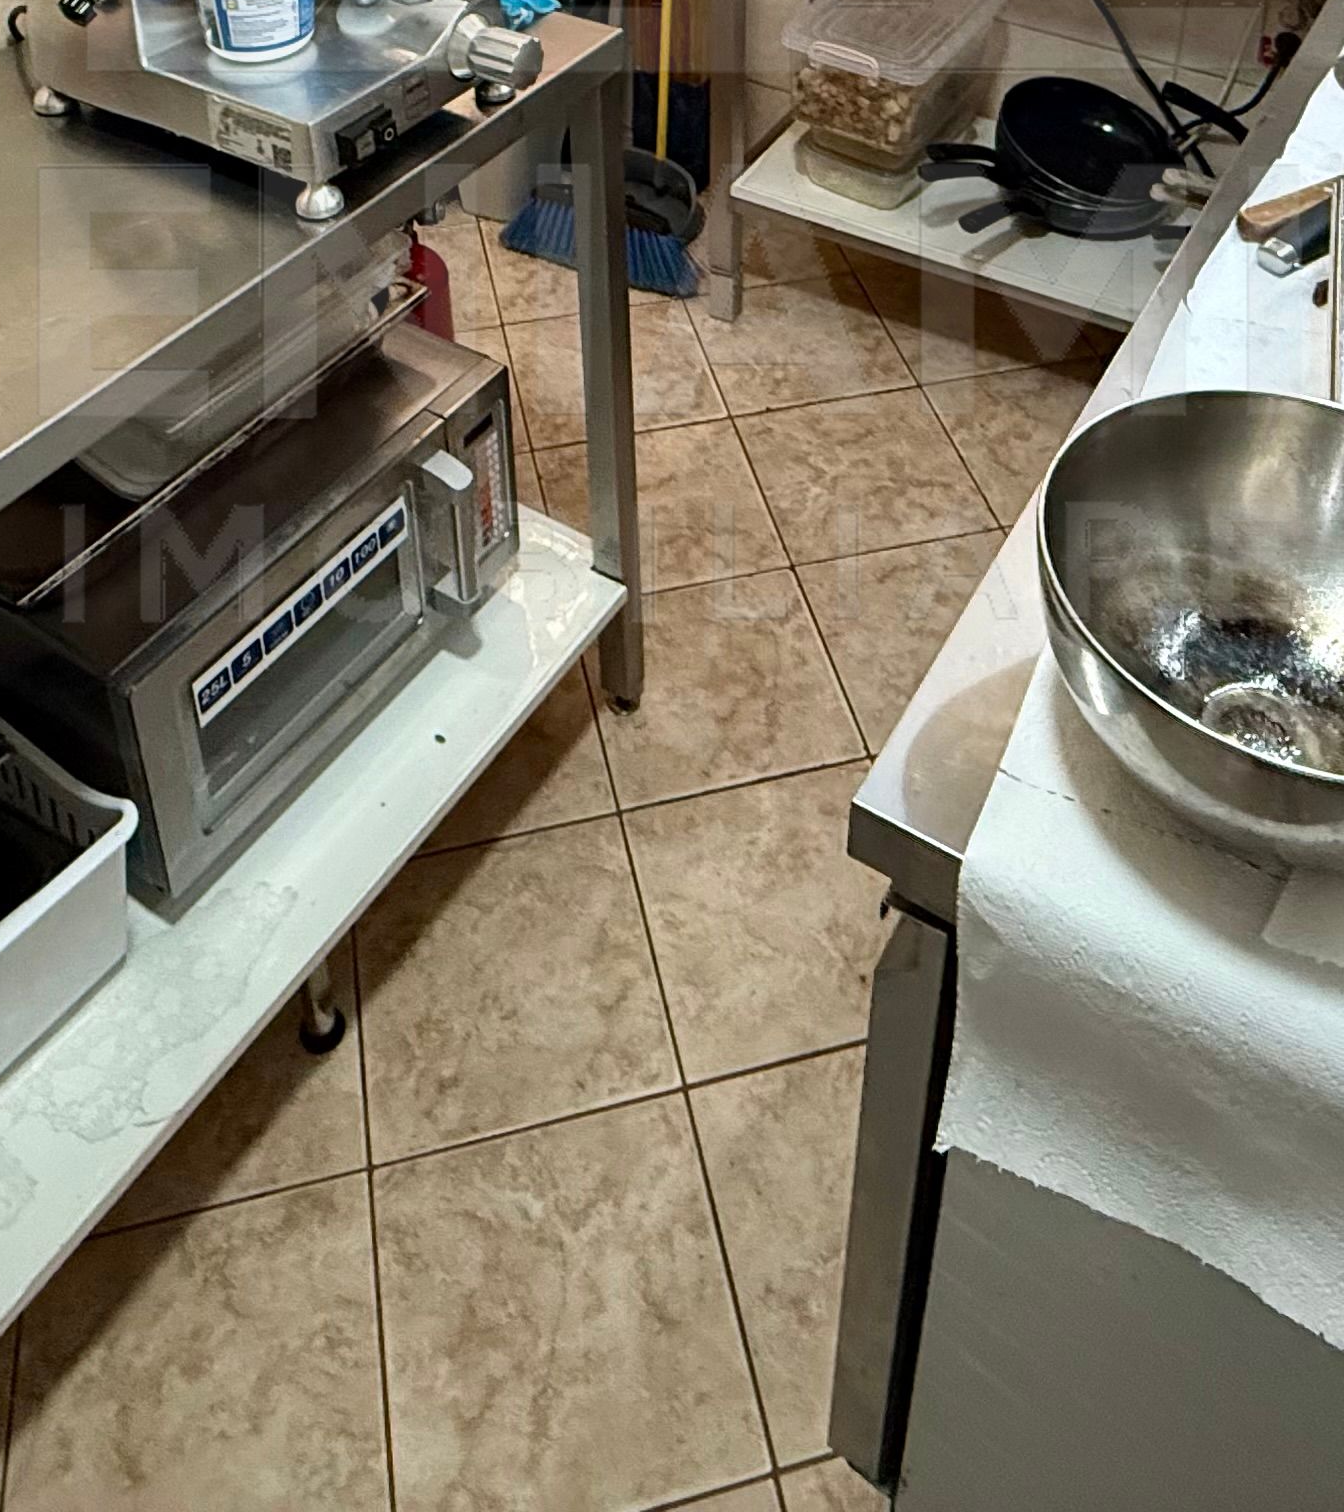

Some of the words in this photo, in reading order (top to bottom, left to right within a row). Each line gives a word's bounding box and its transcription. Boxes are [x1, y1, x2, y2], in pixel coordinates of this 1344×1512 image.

[200, 675, 229, 706] 25L
[328, 565, 346, 588] 10
[355, 536, 378, 564] 100
